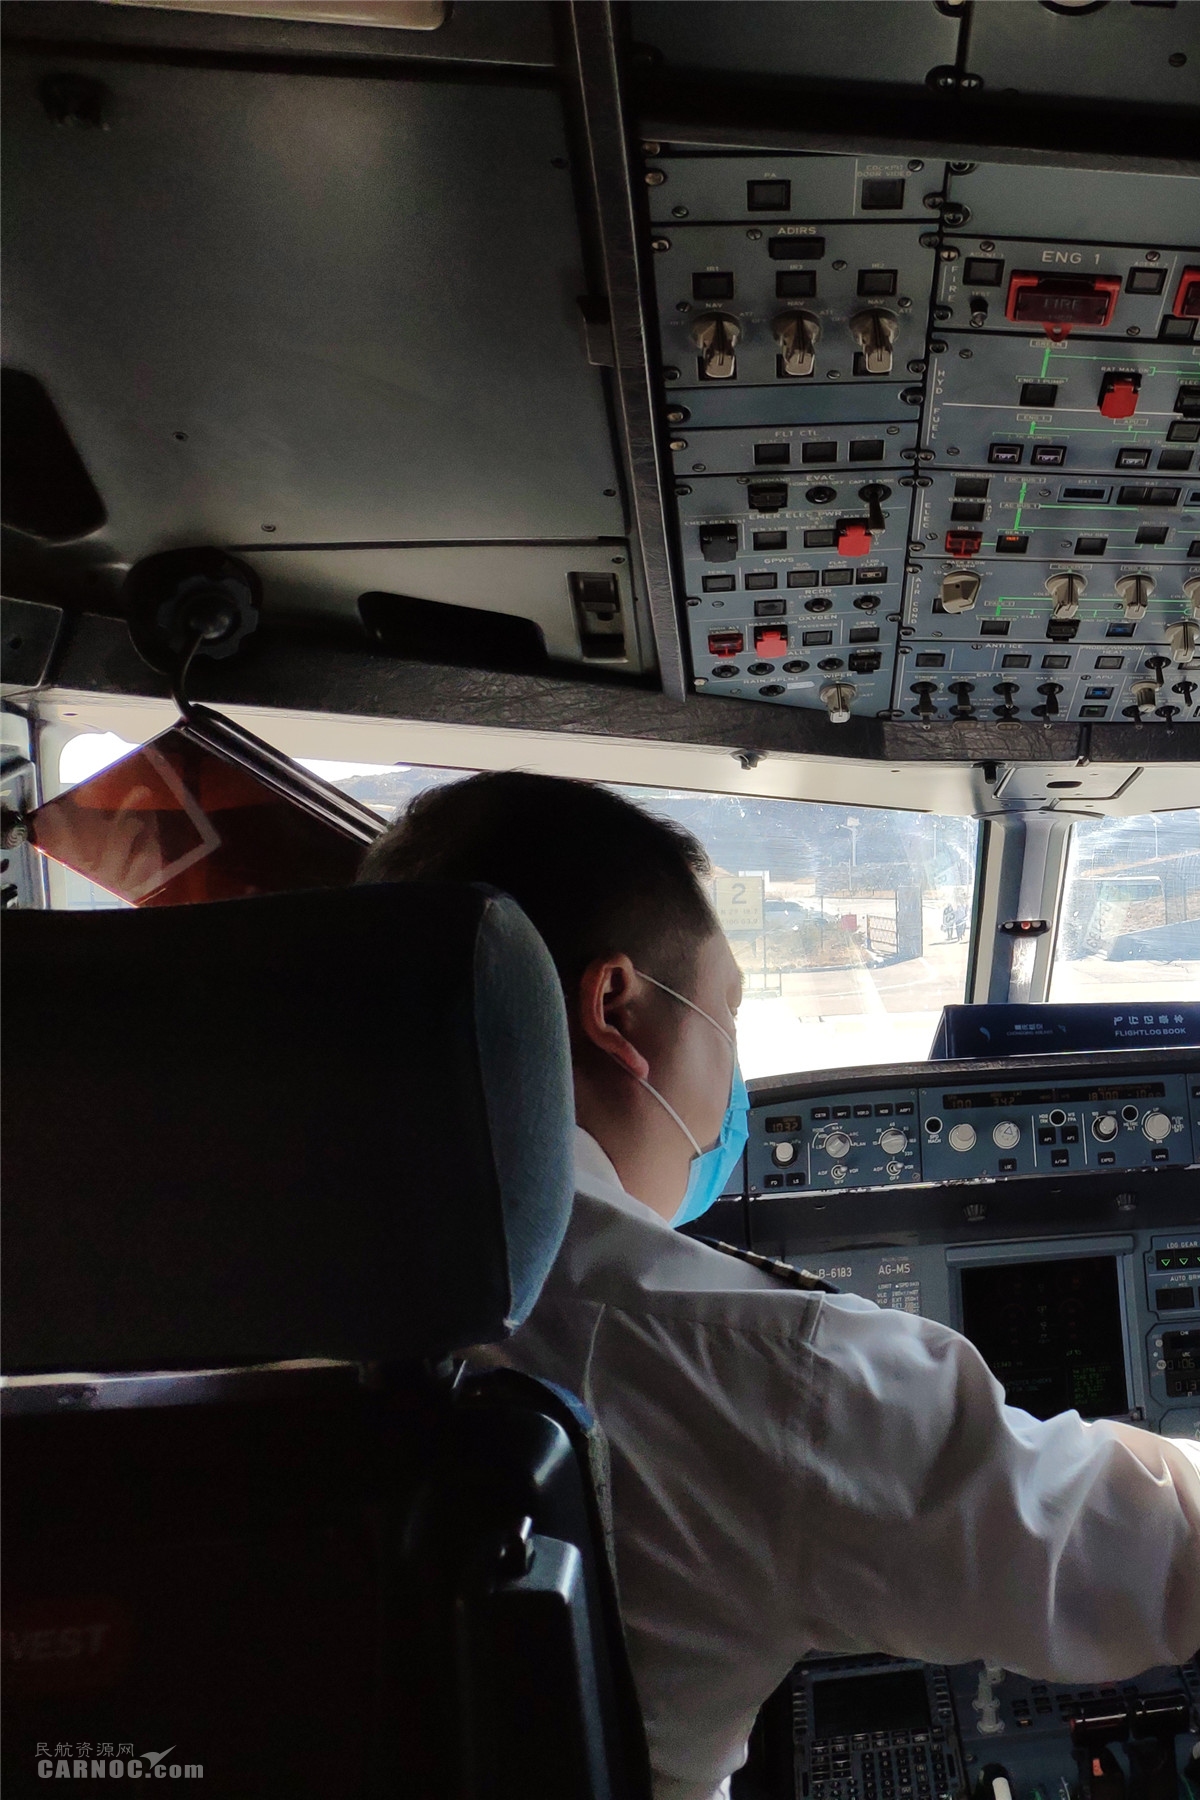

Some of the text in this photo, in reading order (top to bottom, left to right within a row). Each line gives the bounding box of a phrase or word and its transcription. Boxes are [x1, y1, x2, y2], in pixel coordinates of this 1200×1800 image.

[777, 227, 817, 235] ADIRS
[1041, 251, 1101, 265] ENG 1
[1044, 298, 1080, 311] FIRE
[935, 370, 945, 395] HYD
[931, 408, 941, 440] FUEL
[911, 602, 919, 624] COND
[731, 882, 747, 904] 2
[1162, 1027, 1187, 1036] BOOK
[772, 1122, 799, 1132] 1032
[818, 1267, 852, 1279] B-6183
[878, 1263, 911, 1275] AG-MS
